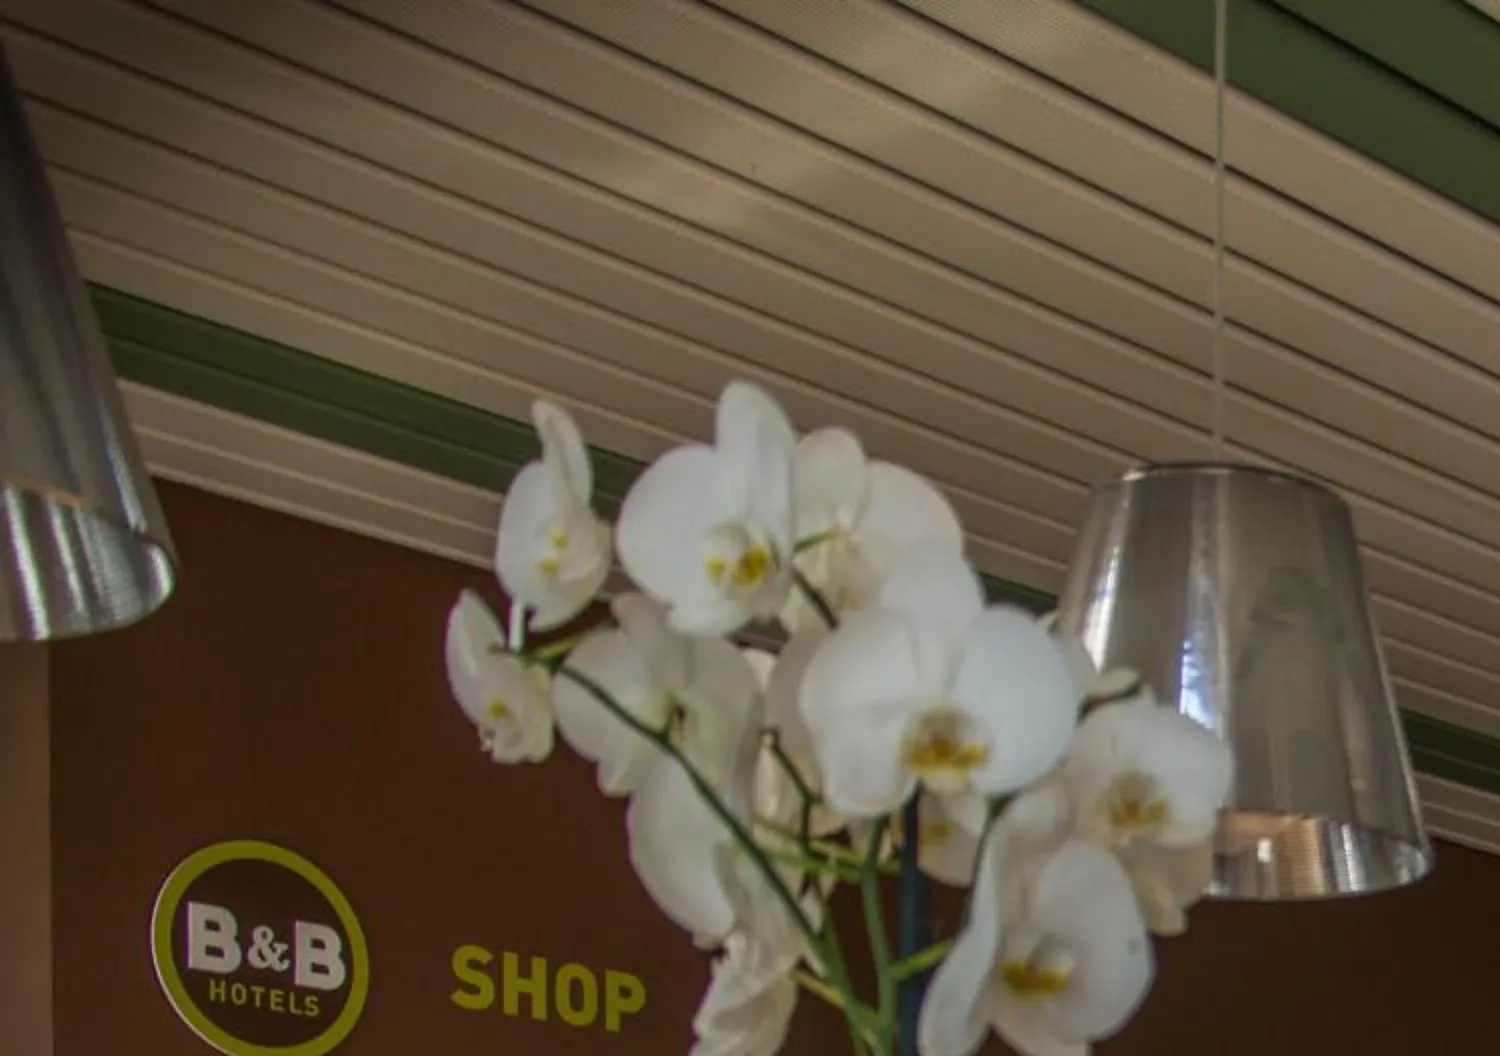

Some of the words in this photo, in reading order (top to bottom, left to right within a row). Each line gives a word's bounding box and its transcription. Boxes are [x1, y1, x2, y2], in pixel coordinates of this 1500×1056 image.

[187, 900, 347, 991] B&B
[450, 944, 647, 1033] SHOP
[208, 980, 321, 1018] HOTELS
